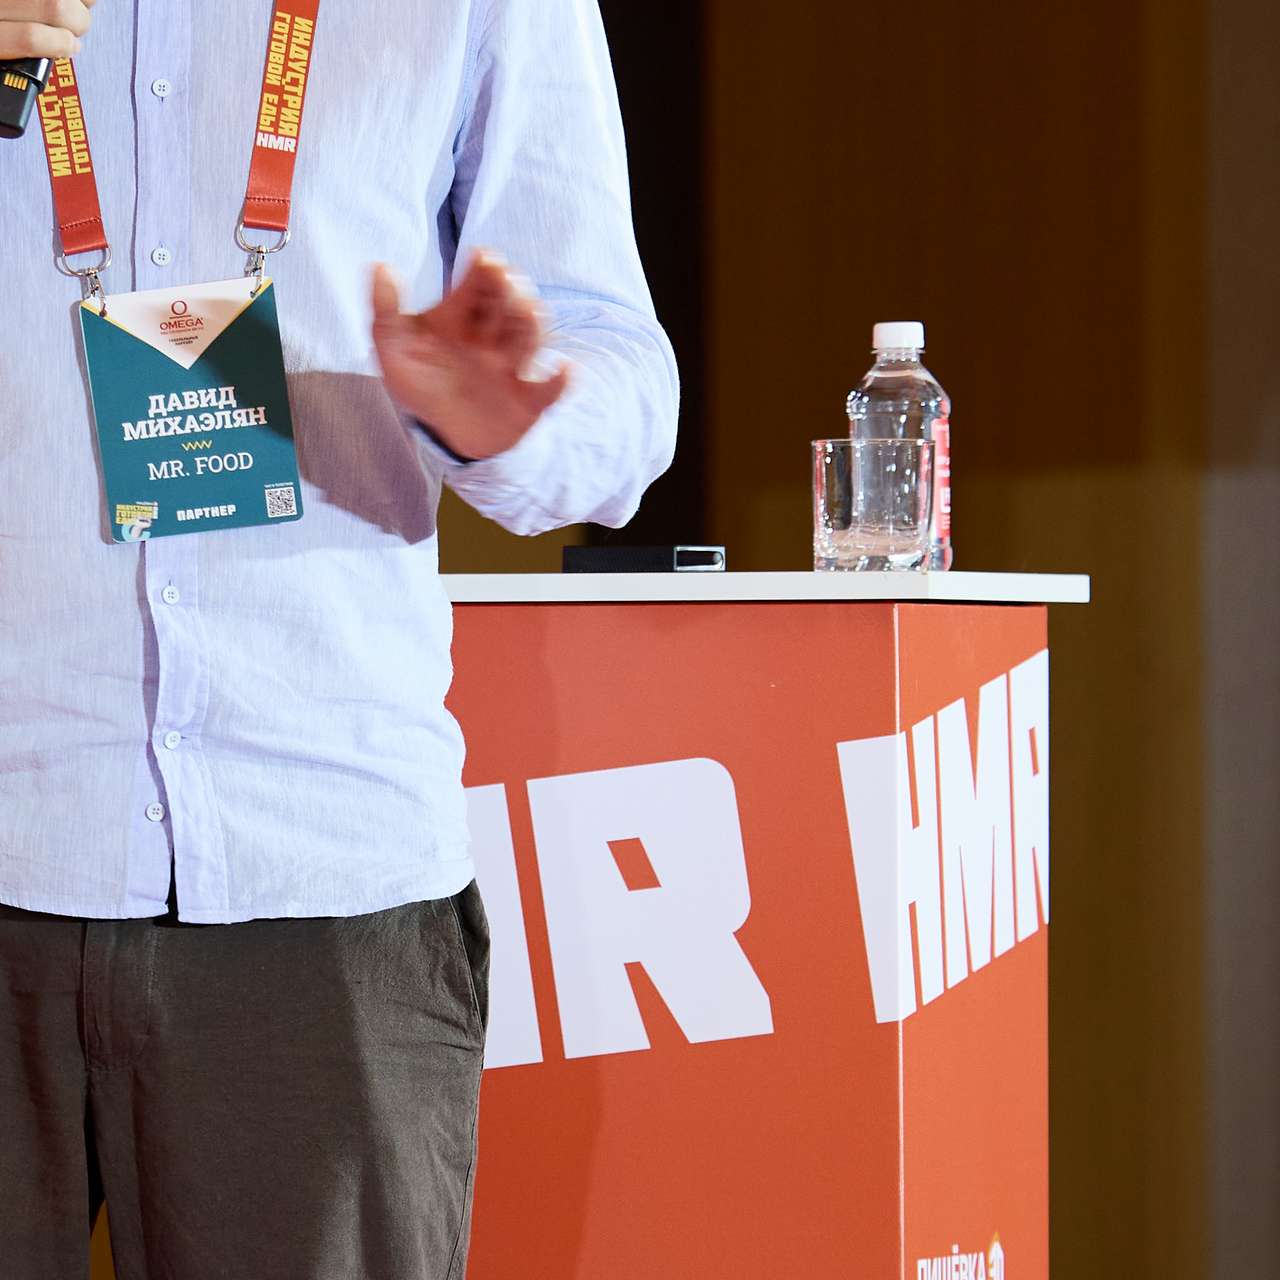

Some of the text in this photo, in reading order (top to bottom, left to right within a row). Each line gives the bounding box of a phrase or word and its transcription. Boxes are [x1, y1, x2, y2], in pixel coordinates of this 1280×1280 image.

[277, 16, 314, 138] ИНДУСТРИЯ
[258, 92, 279, 133] ЕДЫ
[160, 317, 204, 330] OMEGA
[147, 385, 237, 418] ДАВИД
[121, 406, 268, 442] МИХАЭЛЯН
[147, 451, 254, 481] MR. FOOD
[176, 503, 237, 522] ПАРТНЕР
